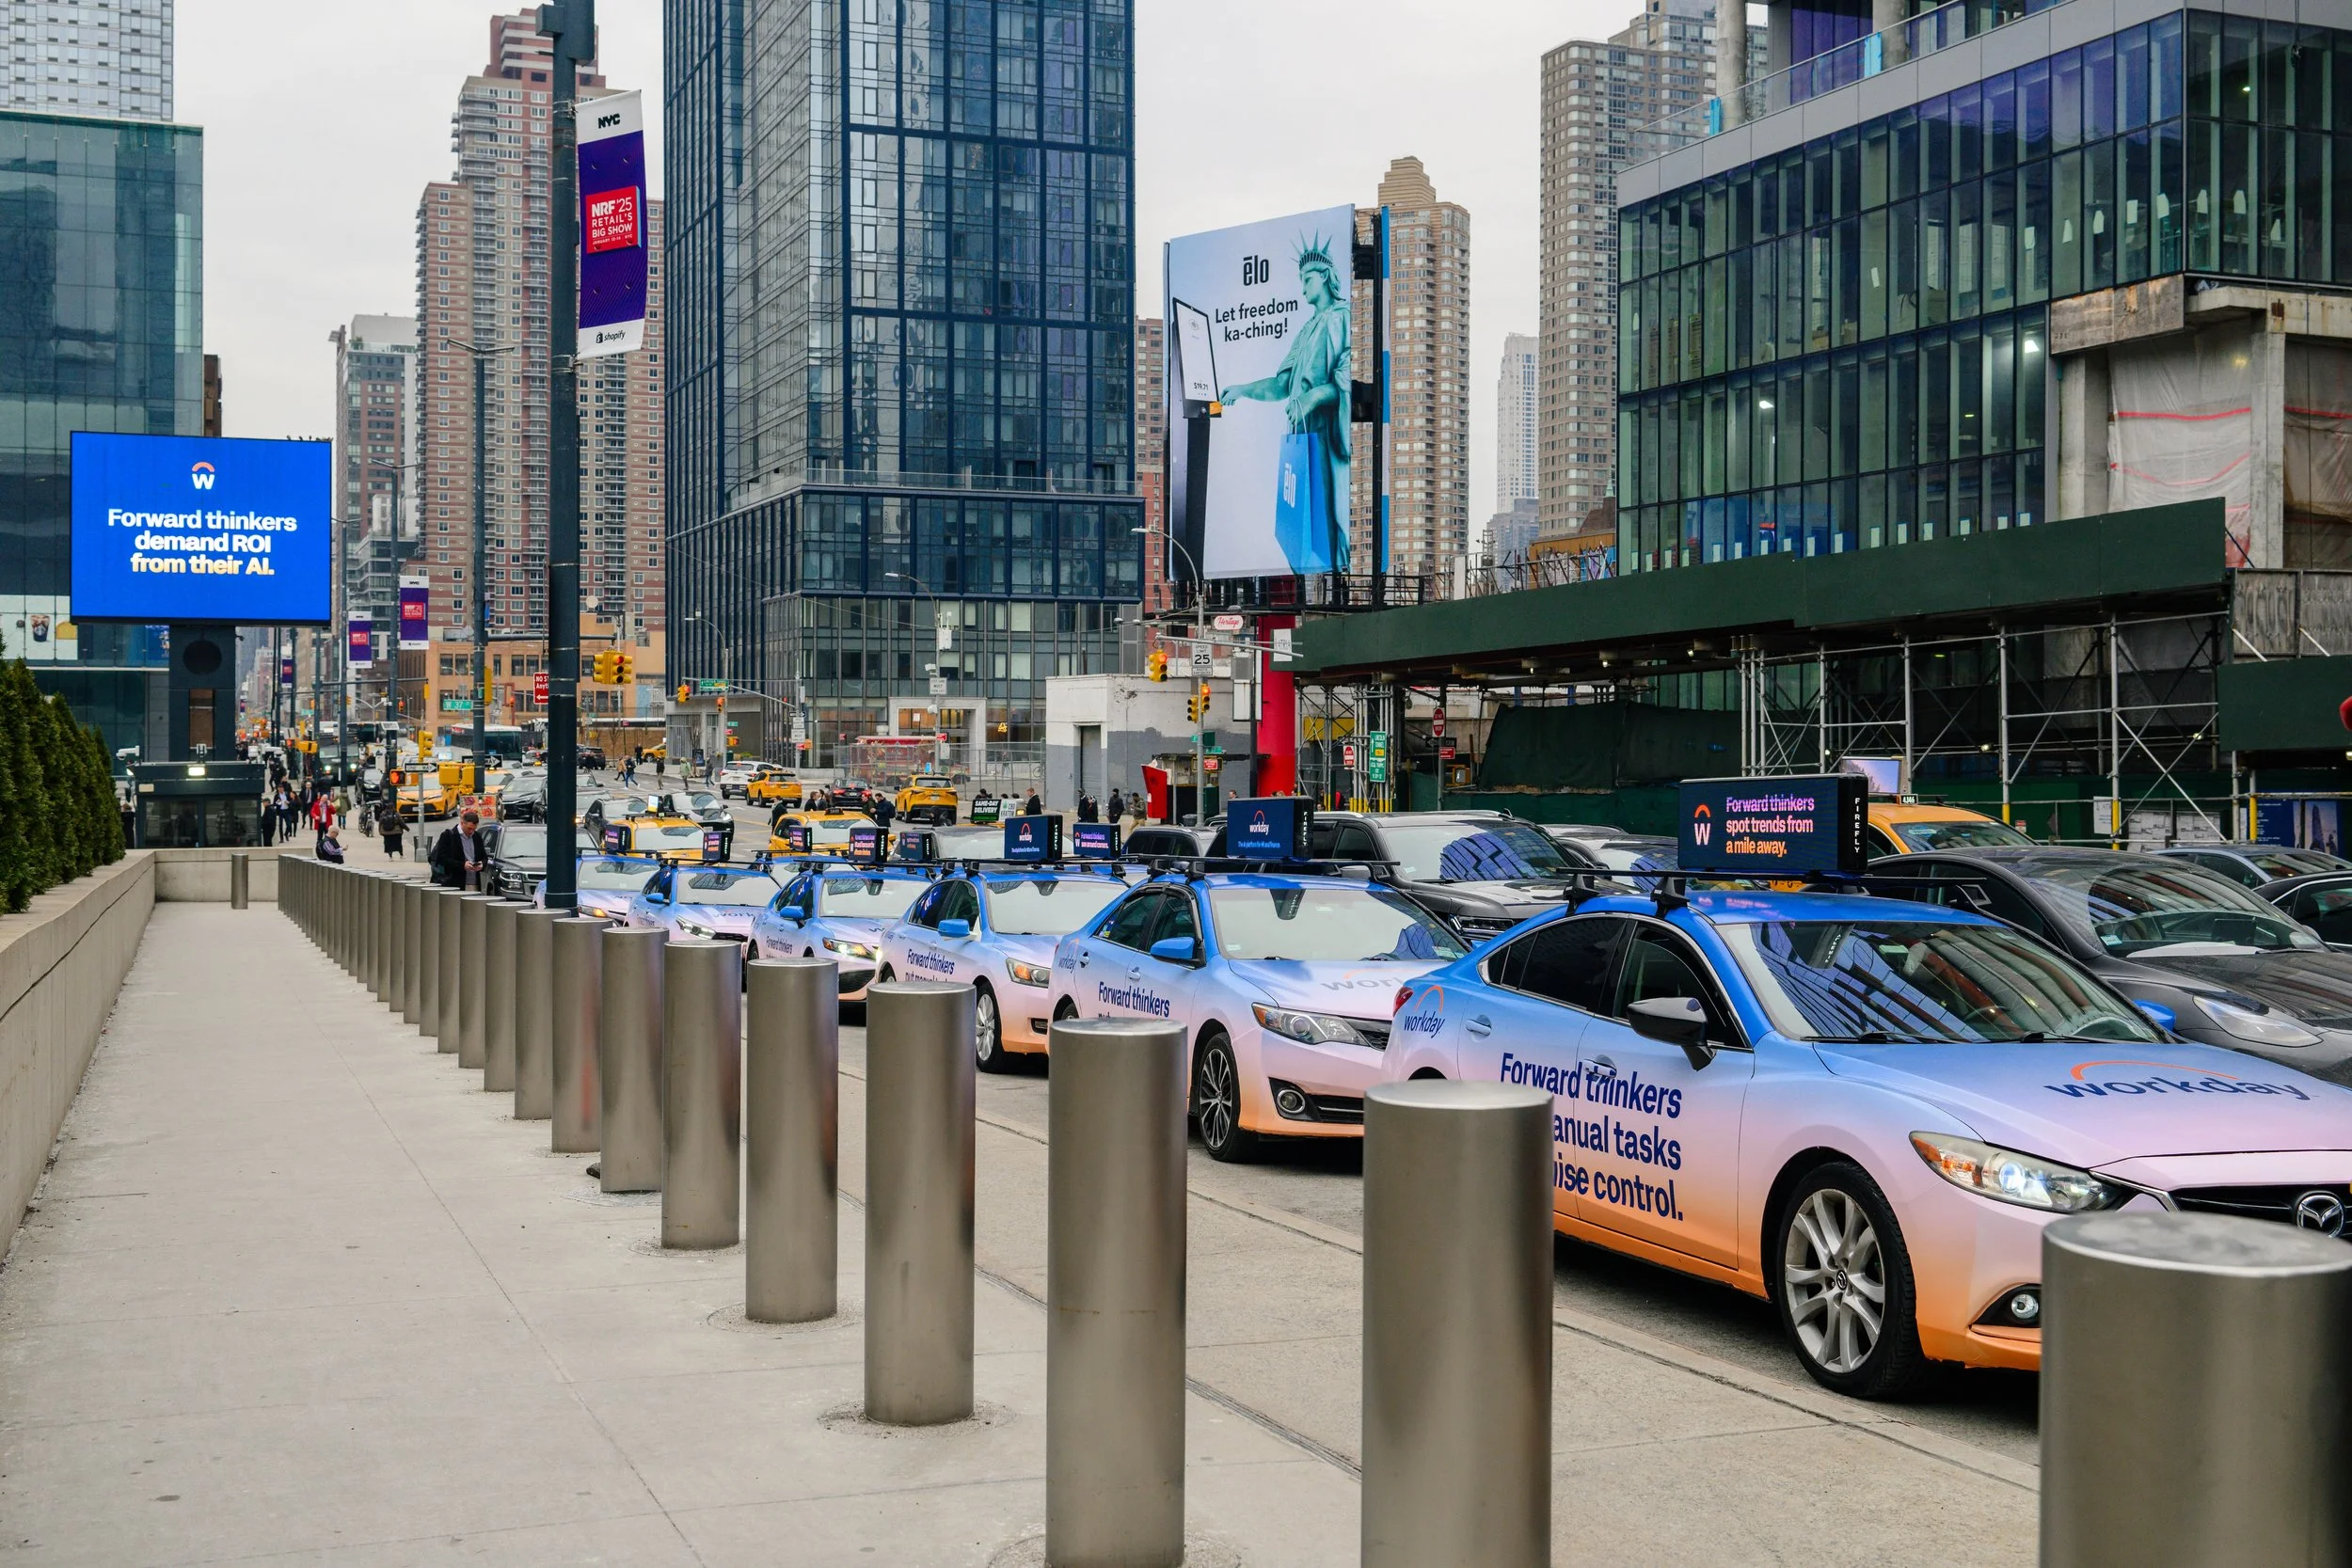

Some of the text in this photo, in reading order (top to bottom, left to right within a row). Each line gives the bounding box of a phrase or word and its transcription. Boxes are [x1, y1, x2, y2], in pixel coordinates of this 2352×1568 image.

[598, 114, 620, 129] NYC
[592, 199, 615, 217] NRF
[592, 213, 632, 228] RETAIL'S
[592, 223, 632, 238] BIG SHOW
[1216, 297, 1298, 324] Let freedom
[604, 330, 626, 341] shopify
[1224, 317, 1288, 342] ka-ching!
[108, 508, 297, 531] Forward thinkers
[135, 531, 272, 553] demand ROI
[130, 553, 275, 575] from their AI.
[1218, 616, 1240, 628] Heritage
[1194, 654, 1211, 664] 25
[1725, 794, 1815, 812] Forward thinkers
[1249, 821, 1269, 835] workday
[1725, 816, 1814, 836] spot trends from
[1725, 836, 1788, 857] a mile away.
[907, 948, 955, 974] Forward thinkers
[1098, 981, 1170, 1018] Forward thinkers
[1404, 1009, 1446, 1038] workday
[1501, 1053, 1682, 1119] Forward thinkers
[2043, 1076, 2312, 1101] workday
[1554, 1114, 1682, 1171] anual tasks
[1594, 1170, 1684, 1221] control.
